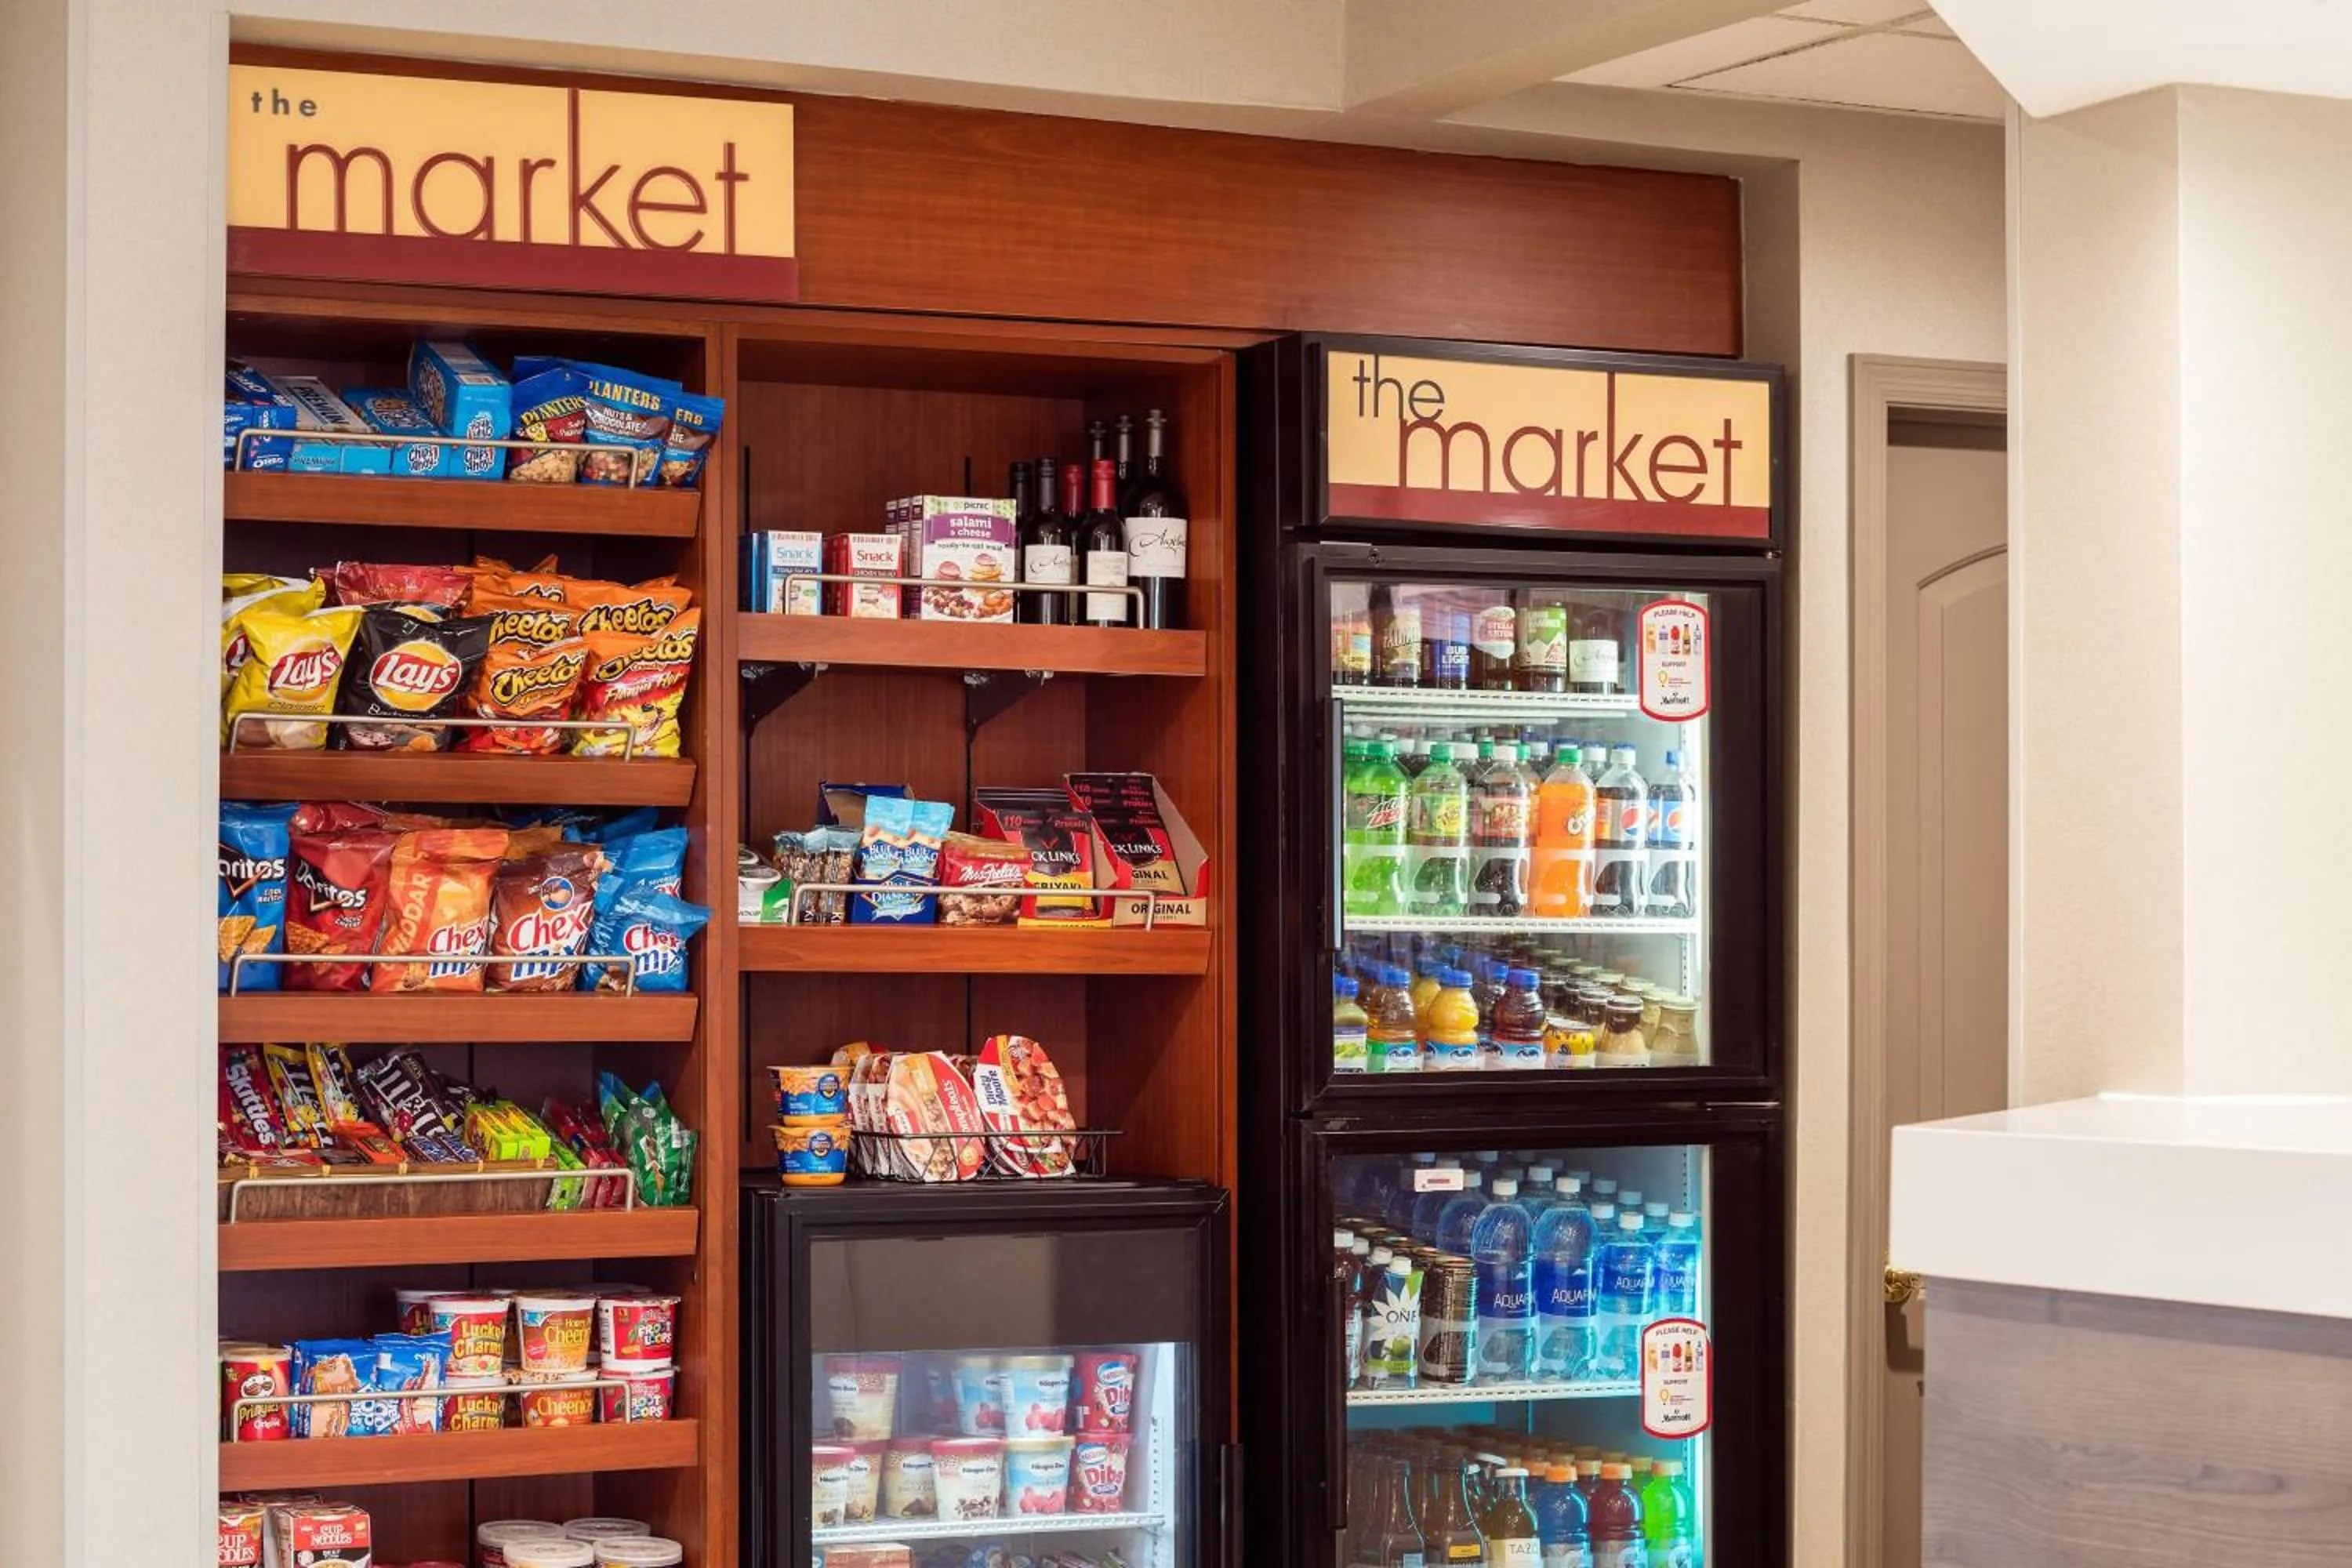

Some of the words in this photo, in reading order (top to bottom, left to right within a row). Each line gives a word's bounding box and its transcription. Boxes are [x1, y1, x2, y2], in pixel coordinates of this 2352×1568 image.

[251, 89, 318, 117] the
[286, 87, 750, 255] market
[1352, 354, 1445, 422] the
[1399, 371, 1743, 506] market
[949, 516, 992, 529] salami
[957, 528, 992, 539] cheese
[777, 546, 813, 560] Snack
[857, 550, 894, 562] Snack
[1445, 646, 1467, 655] BUD
[273, 649, 339, 690] Lay's
[376, 654, 459, 695] Lay's
[1661, 695, 1691, 706] Marriott
[295, 861, 366, 908] Doritos
[1131, 904, 1192, 915] ORGINAL
[509, 906, 589, 953] Chex
[624, 924, 679, 953] Chex
[1385, 1309, 1418, 1323] ONE
[1655, 1326, 1679, 1336] PLEASE
[1661, 1413, 1691, 1423] Marriott
[320, 1524, 344, 1534] CUP
